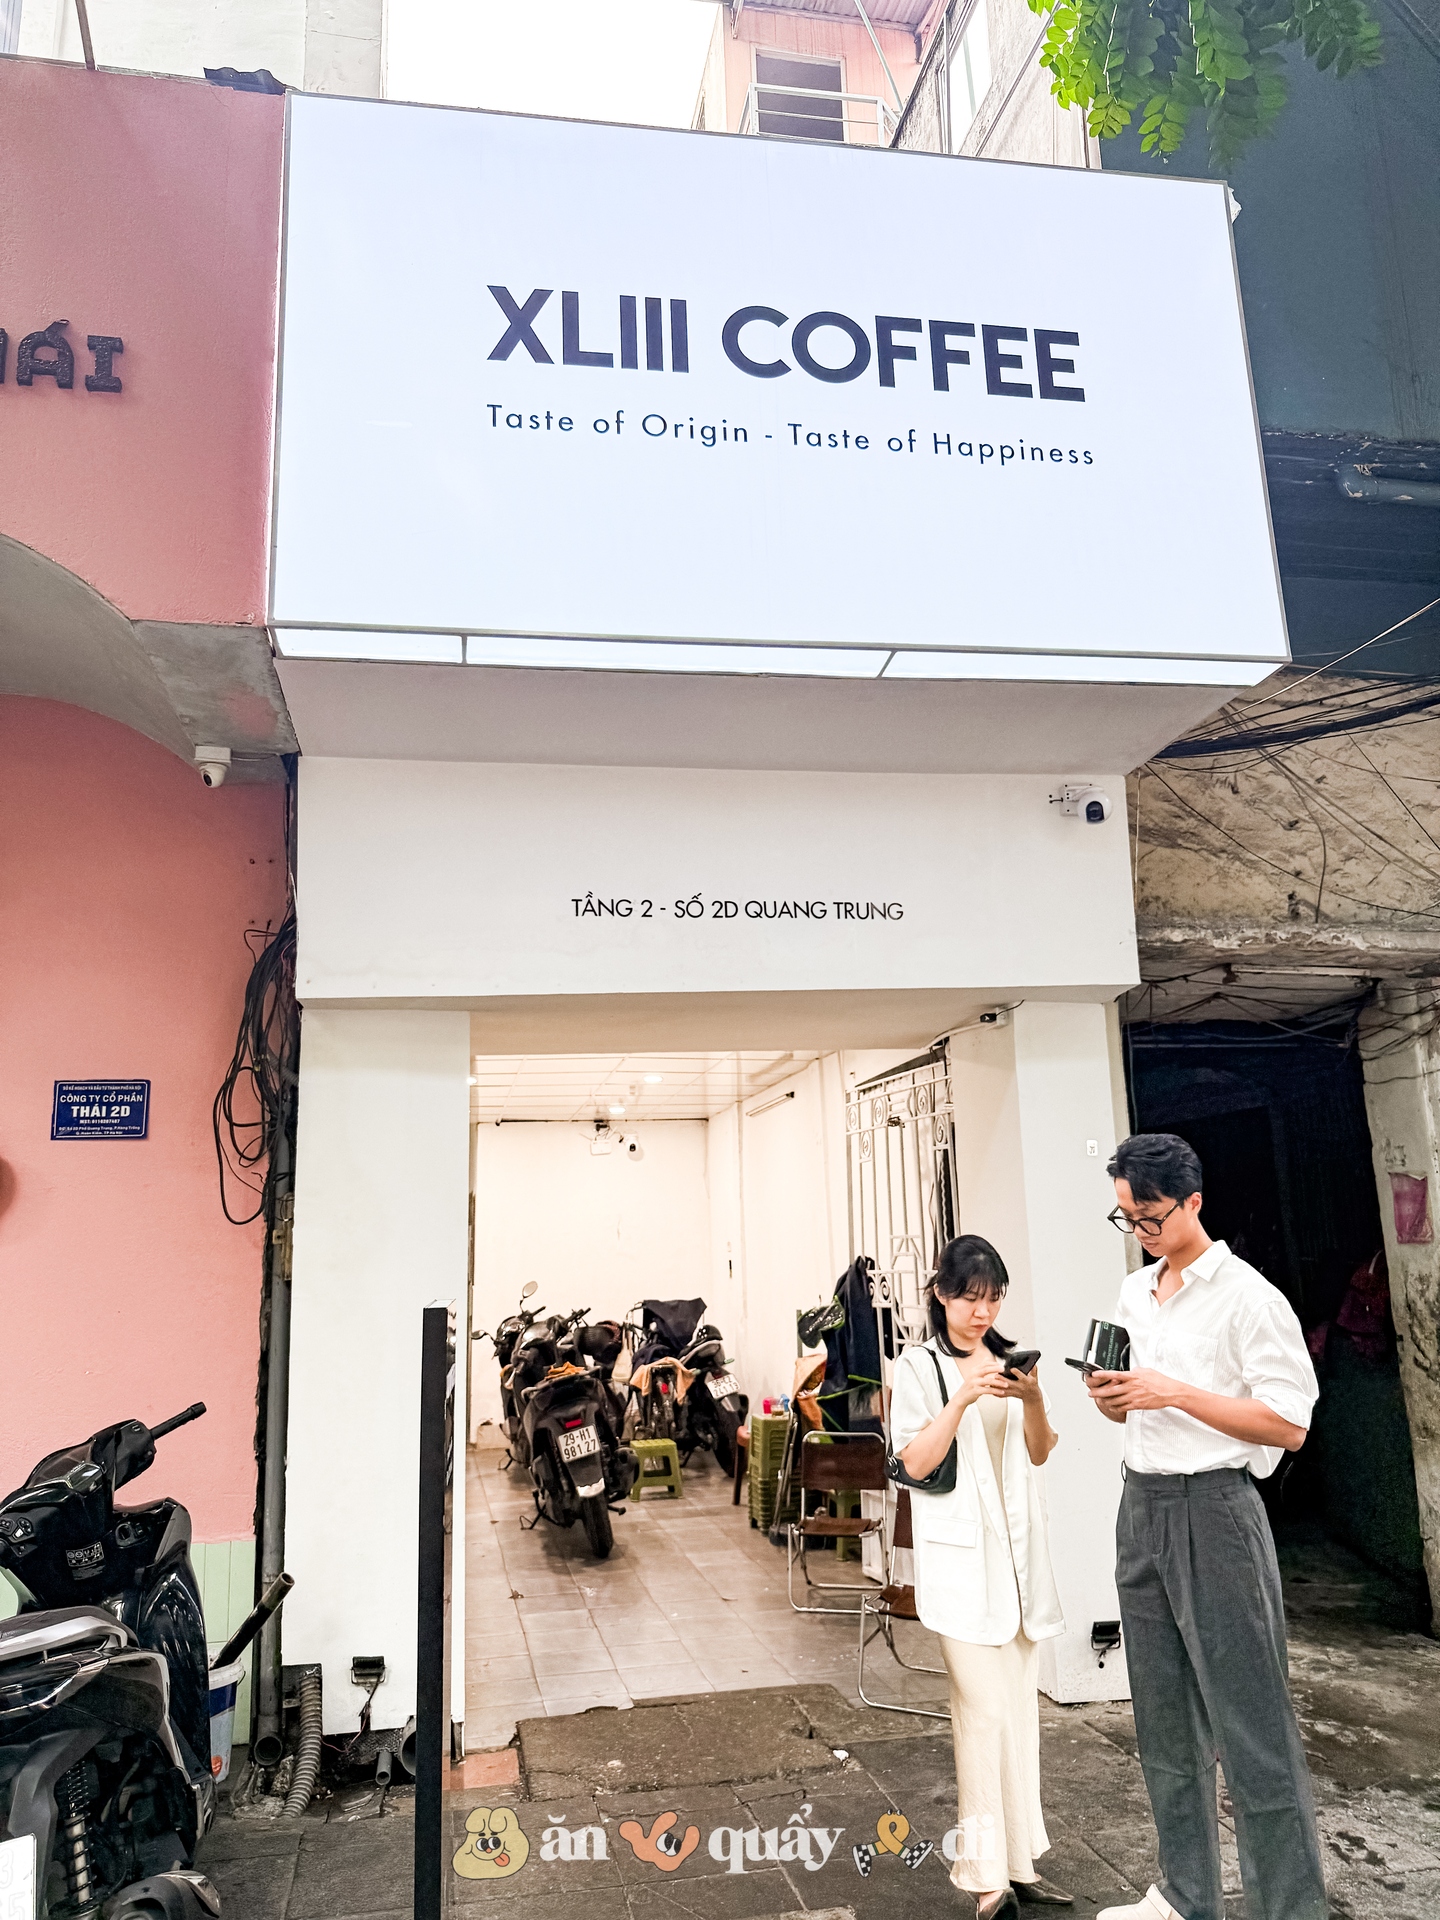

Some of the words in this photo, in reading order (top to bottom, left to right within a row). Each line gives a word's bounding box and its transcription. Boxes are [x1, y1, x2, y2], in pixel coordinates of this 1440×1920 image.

[0, 318, 124, 394] ÁI
[486, 284, 690, 374] XLIII
[721, 305, 1086, 403] COFFEE
[486, 403, 574, 432] Taste
[592, 409, 625, 435] of
[641, 413, 748, 448] Origin
[787, 422, 870, 450] Taste
[887, 428, 917, 453] of
[932, 432, 1094, 467] Happiness
[571, 890, 634, 918] TẦNG
[640, 899, 653, 918] 2
[673, 892, 705, 919] SỐ
[711, 900, 739, 919] 2D
[744, 900, 828, 920] QUANG
[833, 901, 905, 921] TRUNG
[60, 1093, 87, 1103] CÔNG
[88, 1095, 101, 1103] TY
[102, 1091, 117, 1103] CỔ
[71, 1104, 107, 1118] THÁI
[110, 1105, 131, 1118] 2D
[563, 1427, 591, 1447] 29-H1
[563, 1438, 596, 1460] 981.27
